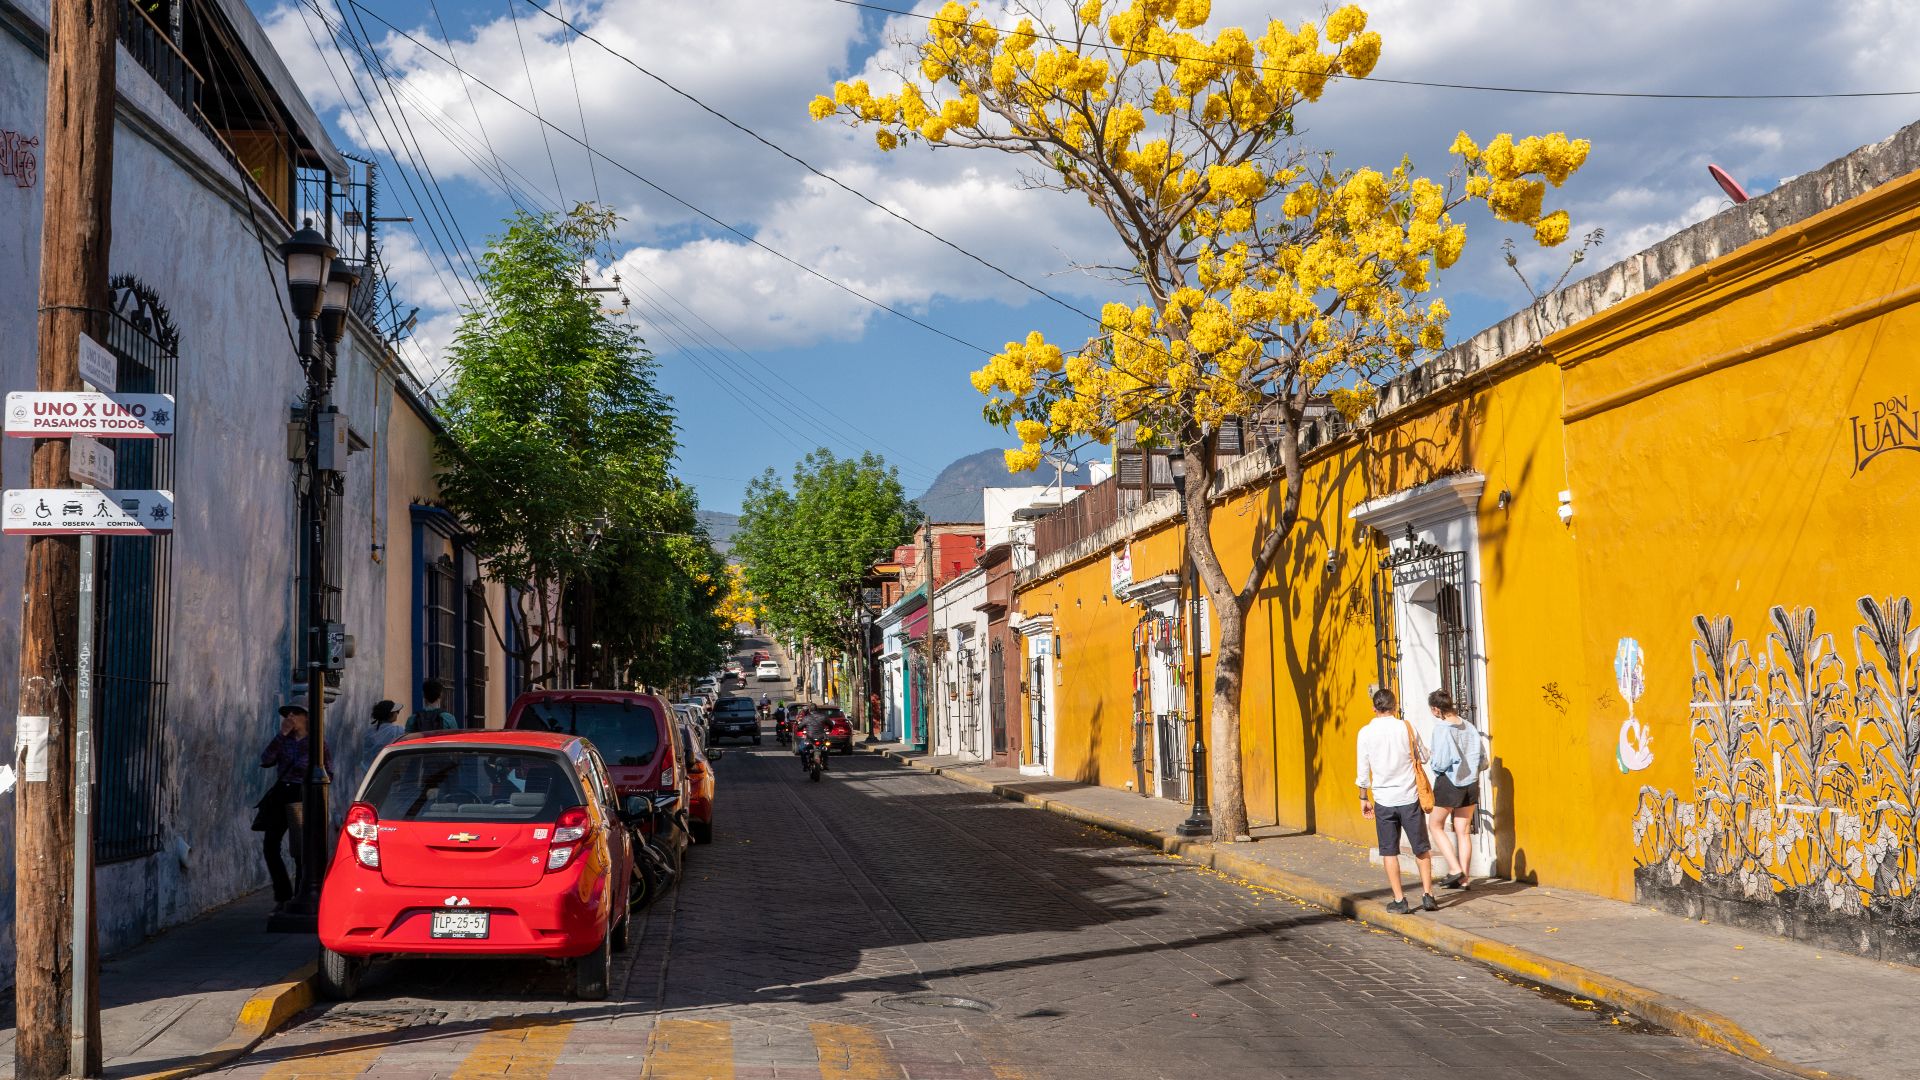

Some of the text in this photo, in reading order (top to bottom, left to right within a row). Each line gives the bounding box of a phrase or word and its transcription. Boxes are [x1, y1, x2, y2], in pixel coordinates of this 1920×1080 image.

[33, 402, 147, 417] UNO X UNO
[1873, 395, 1908, 420] DON
[33, 418, 97, 428] PASAMOS
[101, 419, 145, 429] TODOS
[1849, 410, 1920, 479] JUAN
[434, 916, 486, 928] TLP-25-57
